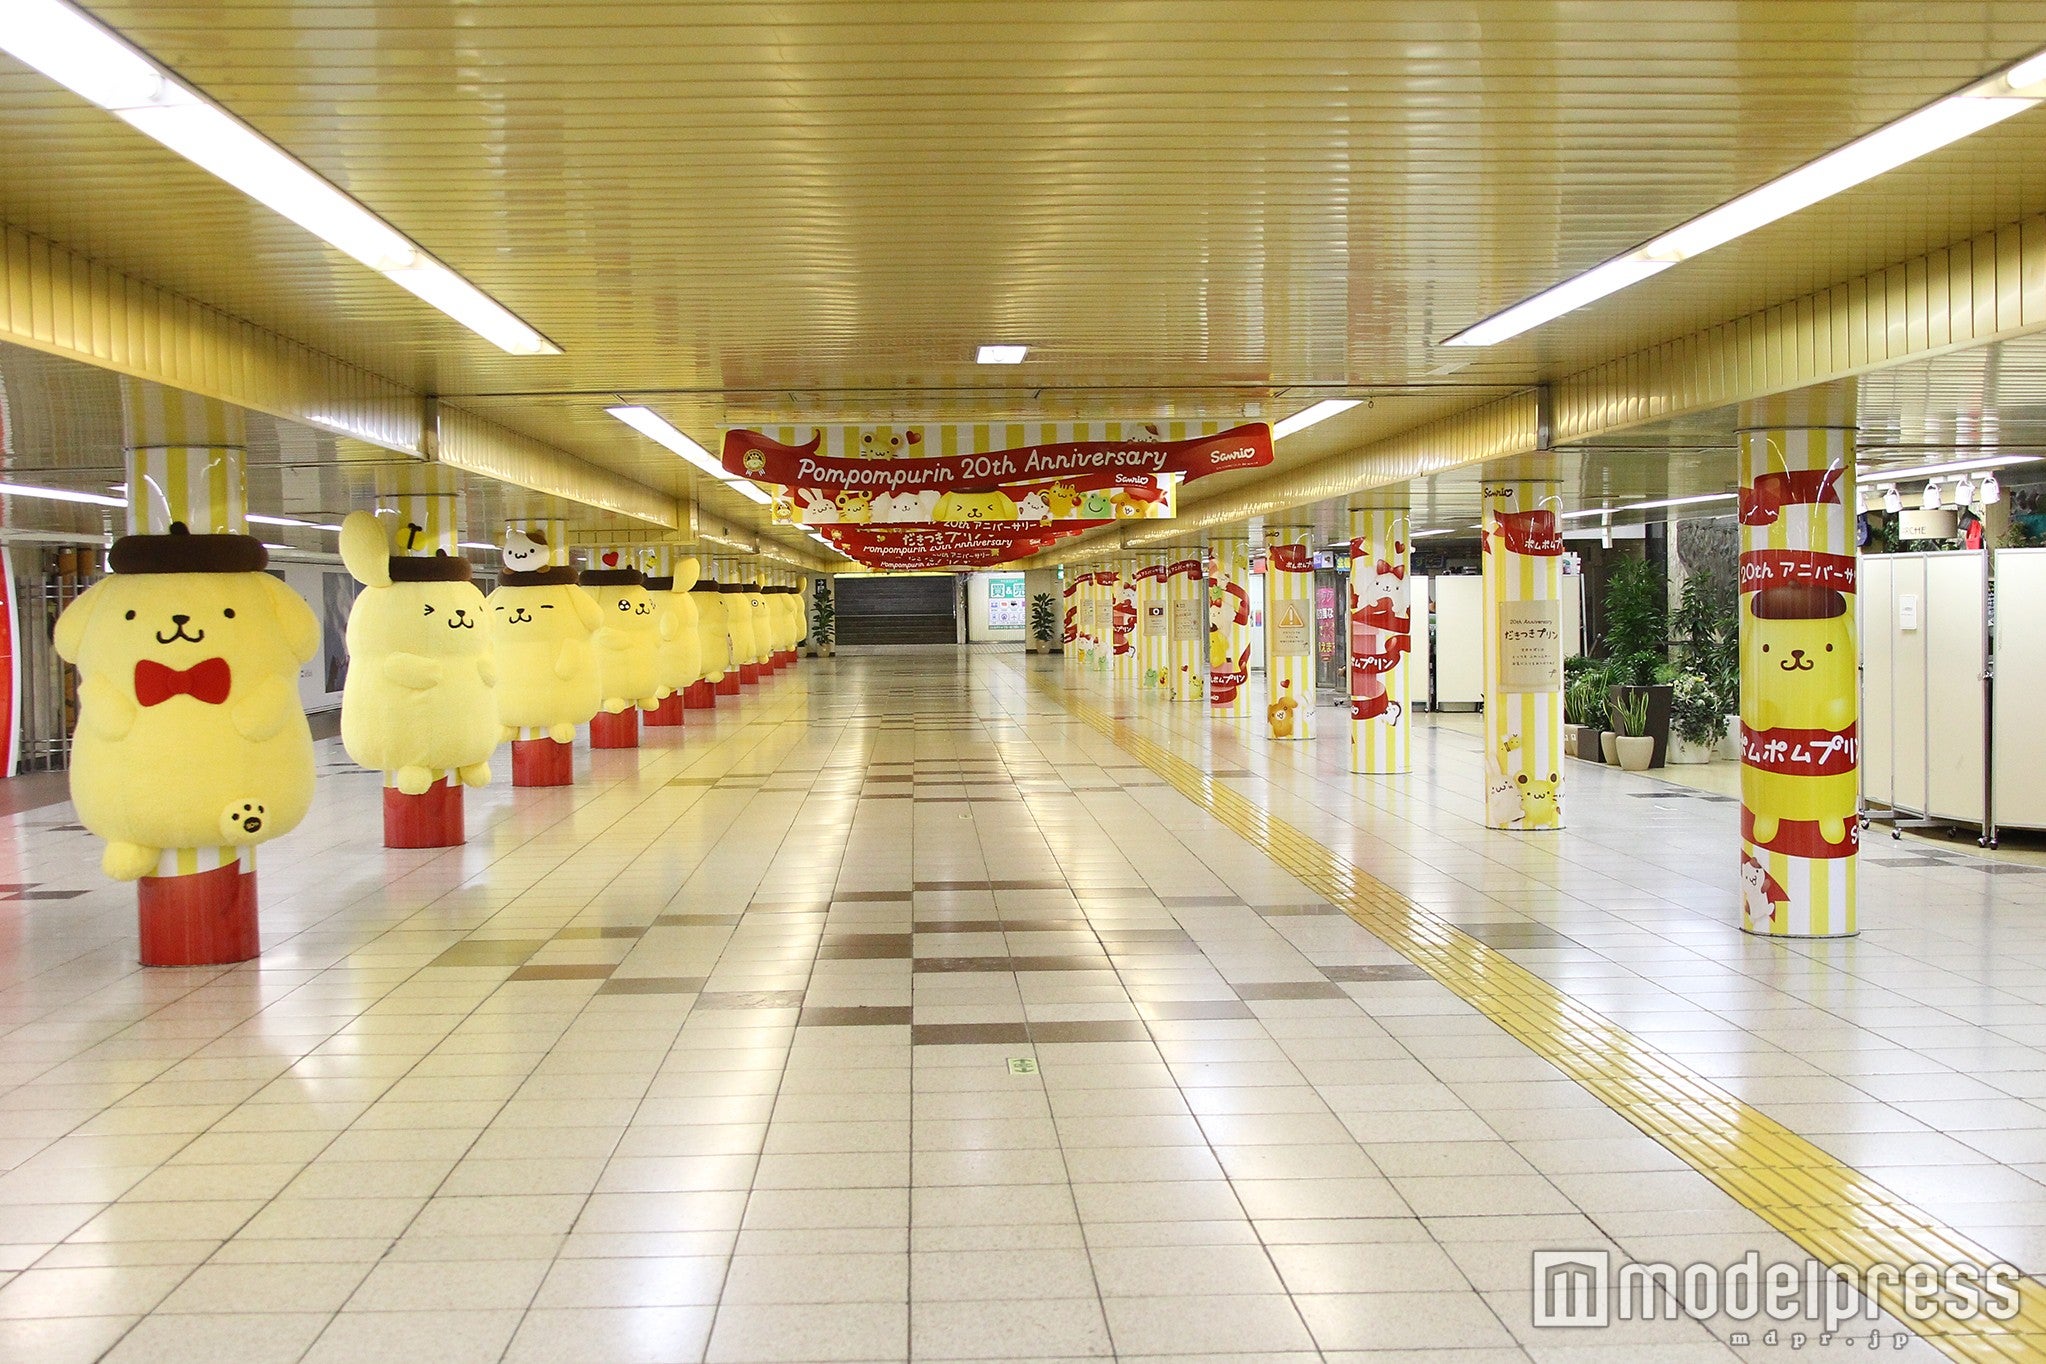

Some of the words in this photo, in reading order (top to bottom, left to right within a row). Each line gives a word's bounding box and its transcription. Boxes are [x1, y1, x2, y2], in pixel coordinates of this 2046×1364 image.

[1210, 447, 1256, 464] Sanrio
[797, 458, 954, 491] Pompompurin
[961, 456, 1017, 480] 20th
[1023, 448, 1168, 473] Anniversary
[1115, 473, 1149, 485] Sanrio
[1741, 561, 1774, 584] 20th
[1505, 628, 1558, 640] だきつきプリン
